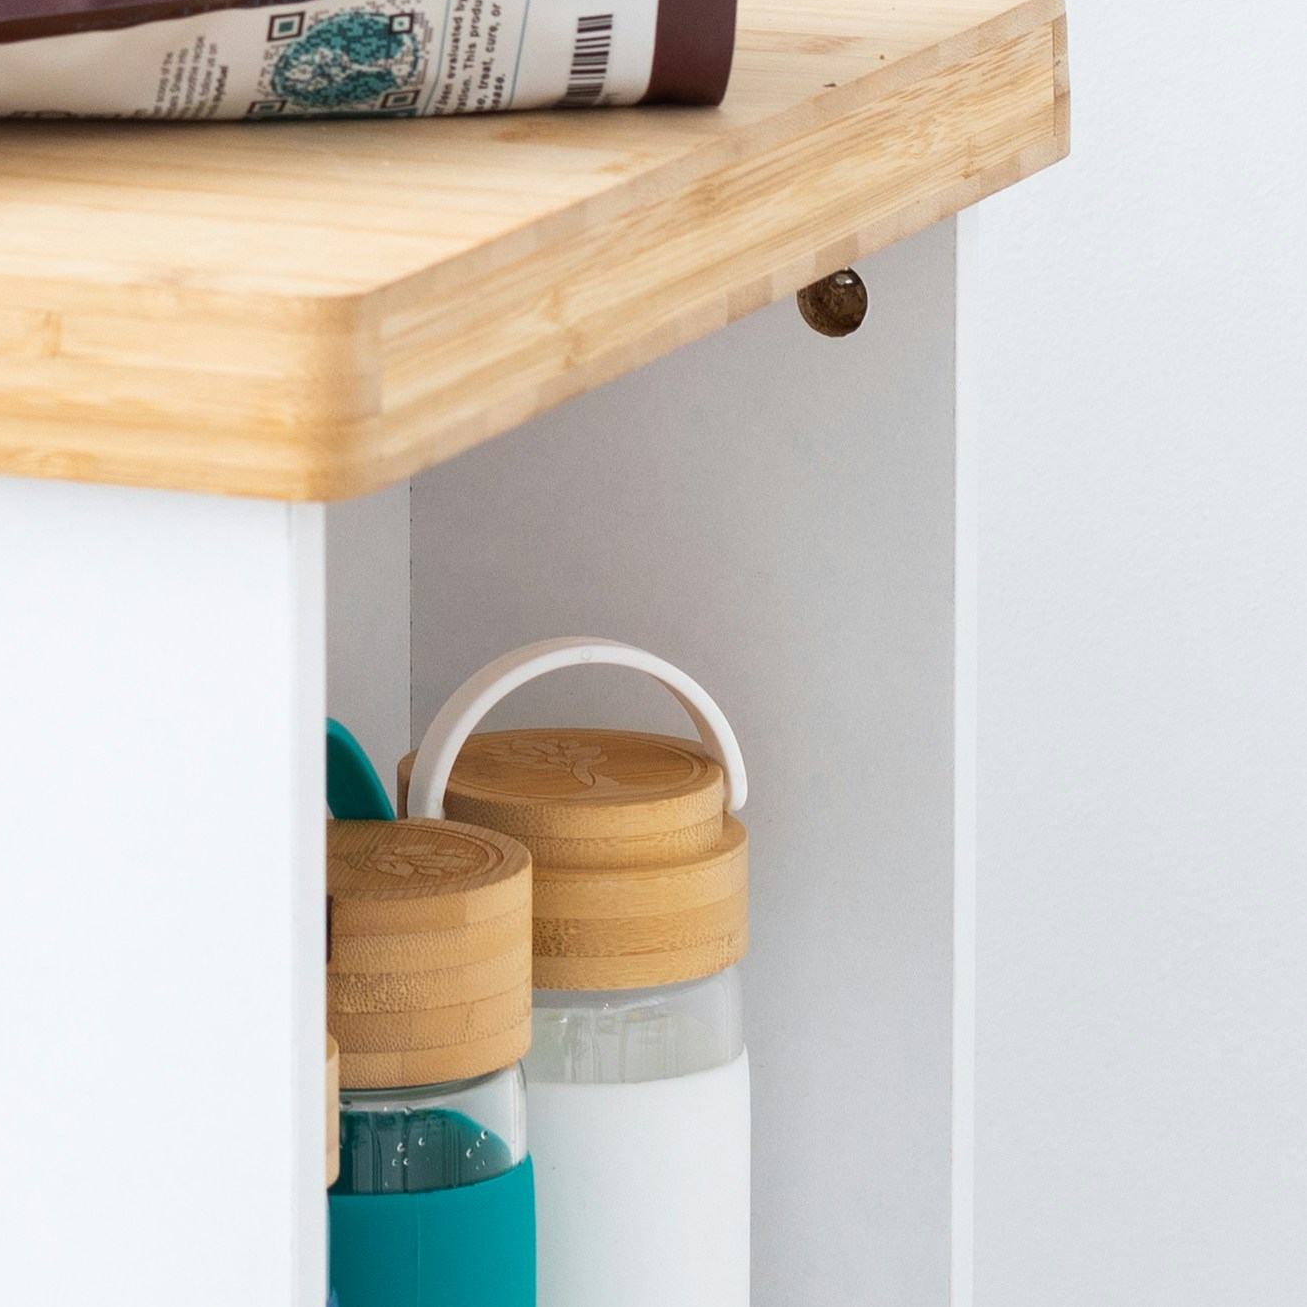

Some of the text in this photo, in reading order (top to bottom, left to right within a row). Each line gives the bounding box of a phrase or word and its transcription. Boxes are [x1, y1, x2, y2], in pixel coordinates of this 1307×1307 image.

[491, 3, 501, 17] or
[447, 16, 463, 79] evaluated
[463, 43, 477, 70] This
